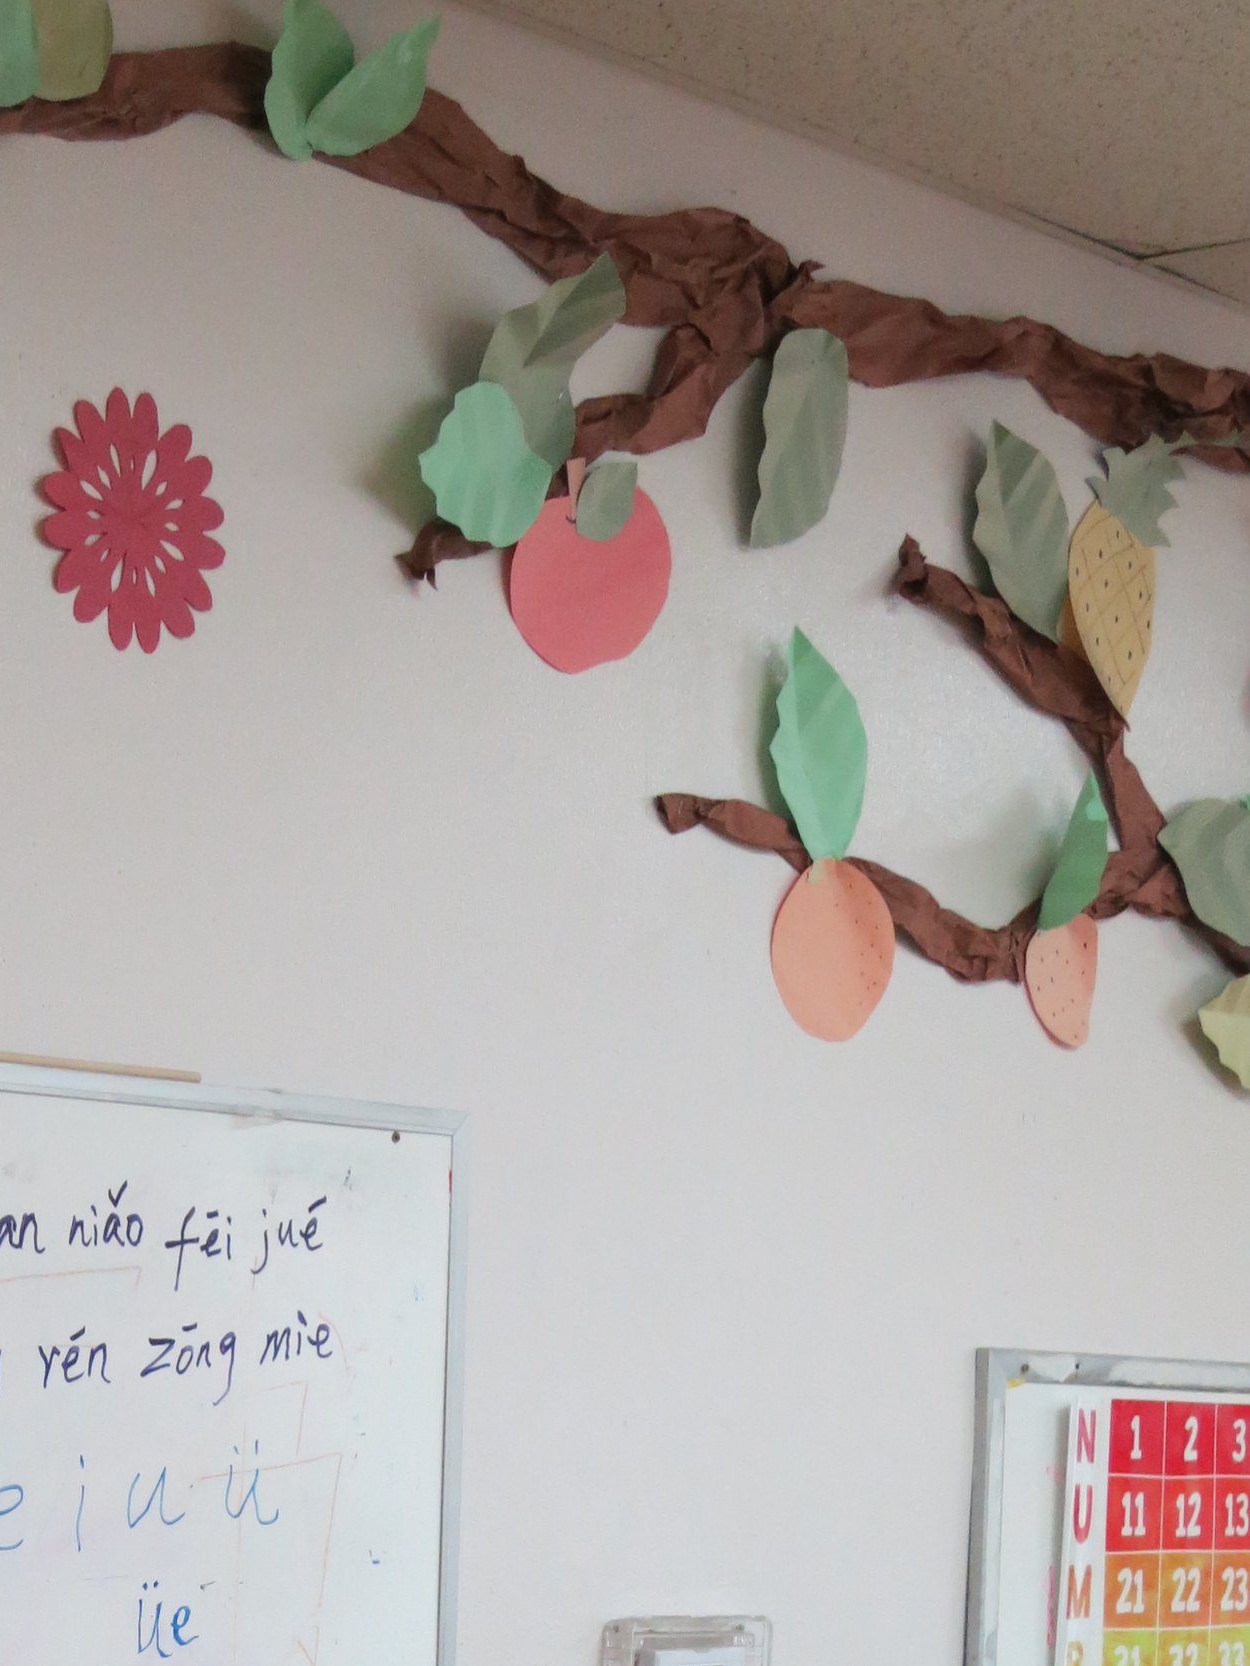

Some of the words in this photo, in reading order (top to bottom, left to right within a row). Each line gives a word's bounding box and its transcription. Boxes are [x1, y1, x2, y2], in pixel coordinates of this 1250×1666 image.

[1130, 1415, 1142, 1460] 1
[1184, 1416, 1198, 1462] 2
[1232, 1419, 1246, 1462] 3
[75, 1454, 86, 1552] i
[127, 1465, 186, 1528] u
[224, 1439, 279, 1526] ü
[1121, 1492, 1146, 1537] 11
[1175, 1492, 1201, 1537] 12
[1225, 1493, 1249, 1536] 13
[1115, 1567, 1145, 1614] 21
[1171, 1567, 1200, 1613] 22
[1220, 1567, 1249, 1612] 23
